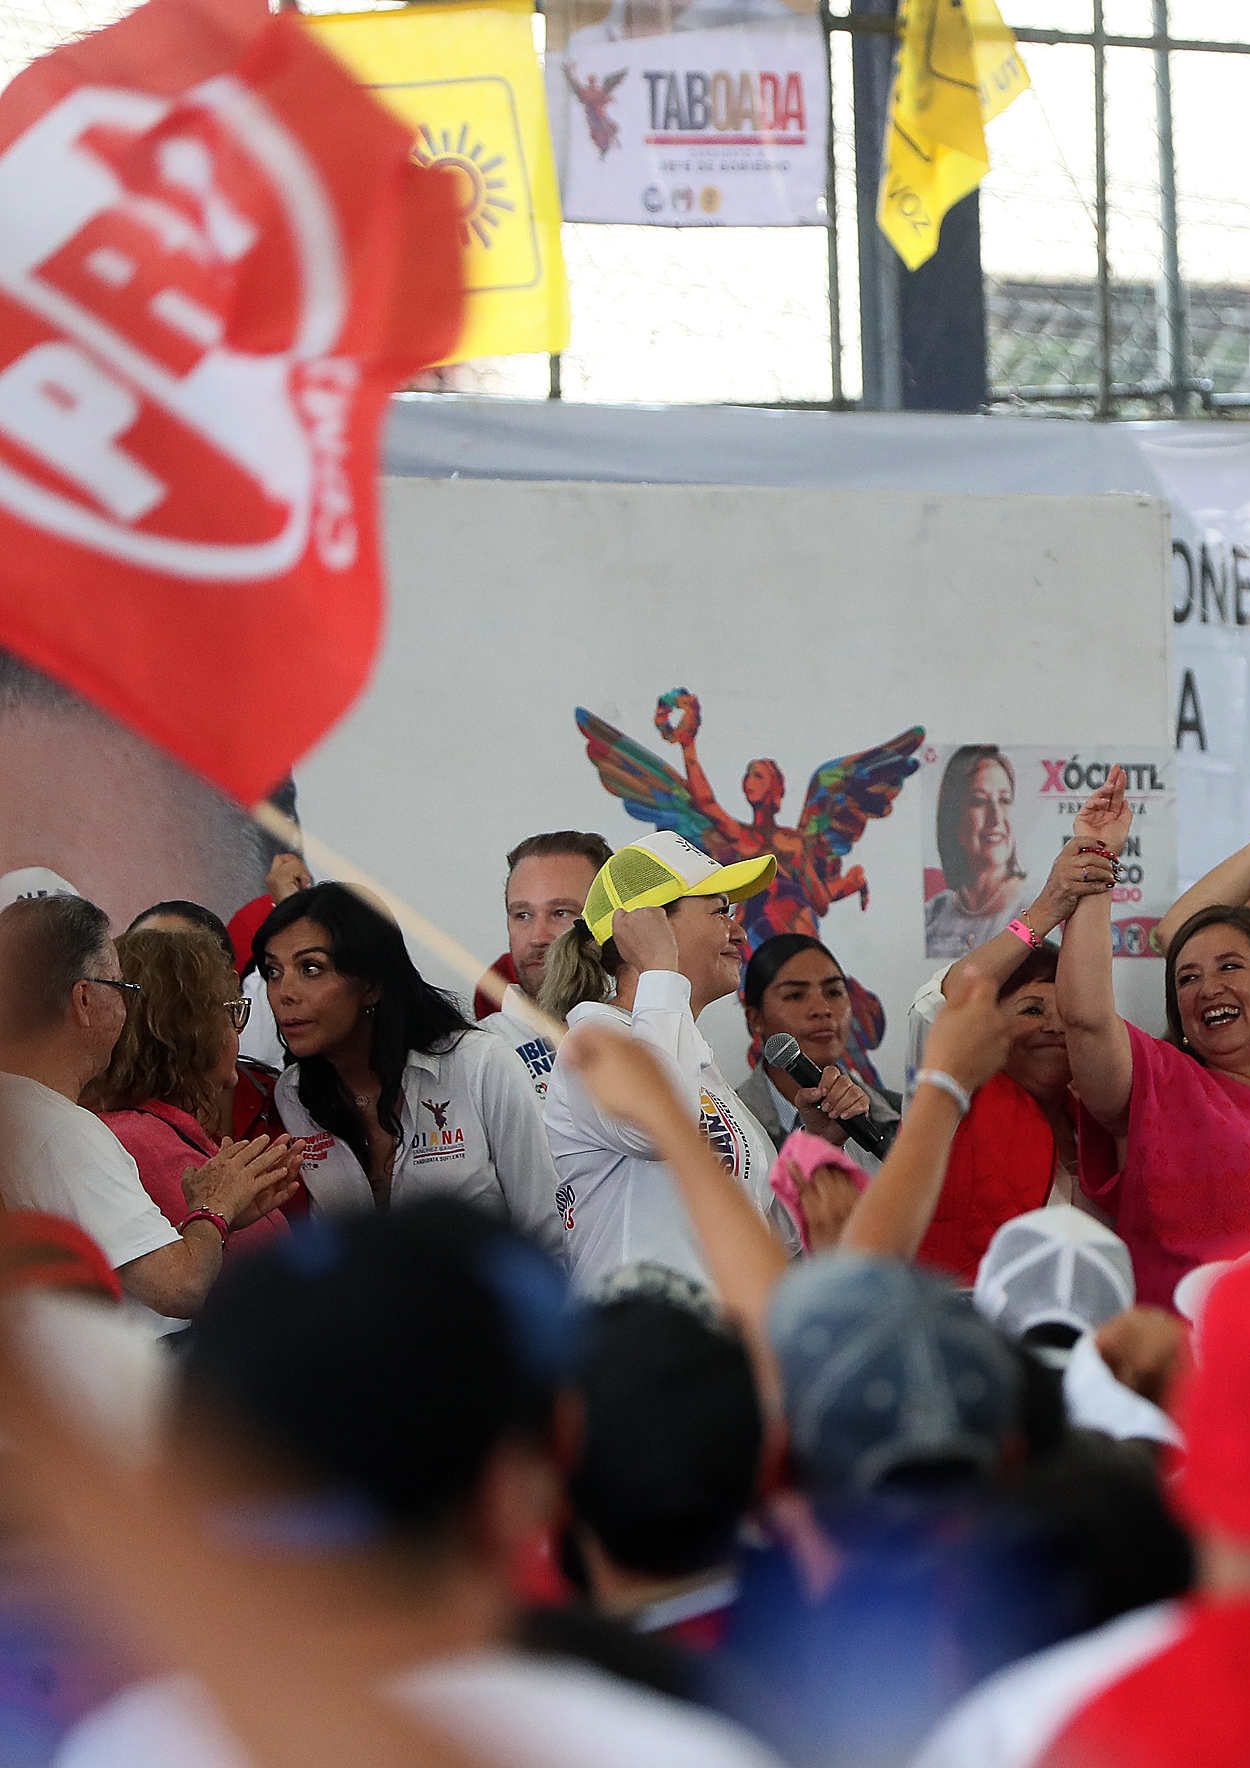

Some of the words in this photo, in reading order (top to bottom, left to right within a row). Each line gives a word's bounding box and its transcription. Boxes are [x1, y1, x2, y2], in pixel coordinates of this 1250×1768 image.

[642, 70, 806, 132] TABOADA
[1174, 669, 1207, 752] A
[412, 1128, 464, 1149] DIANA
